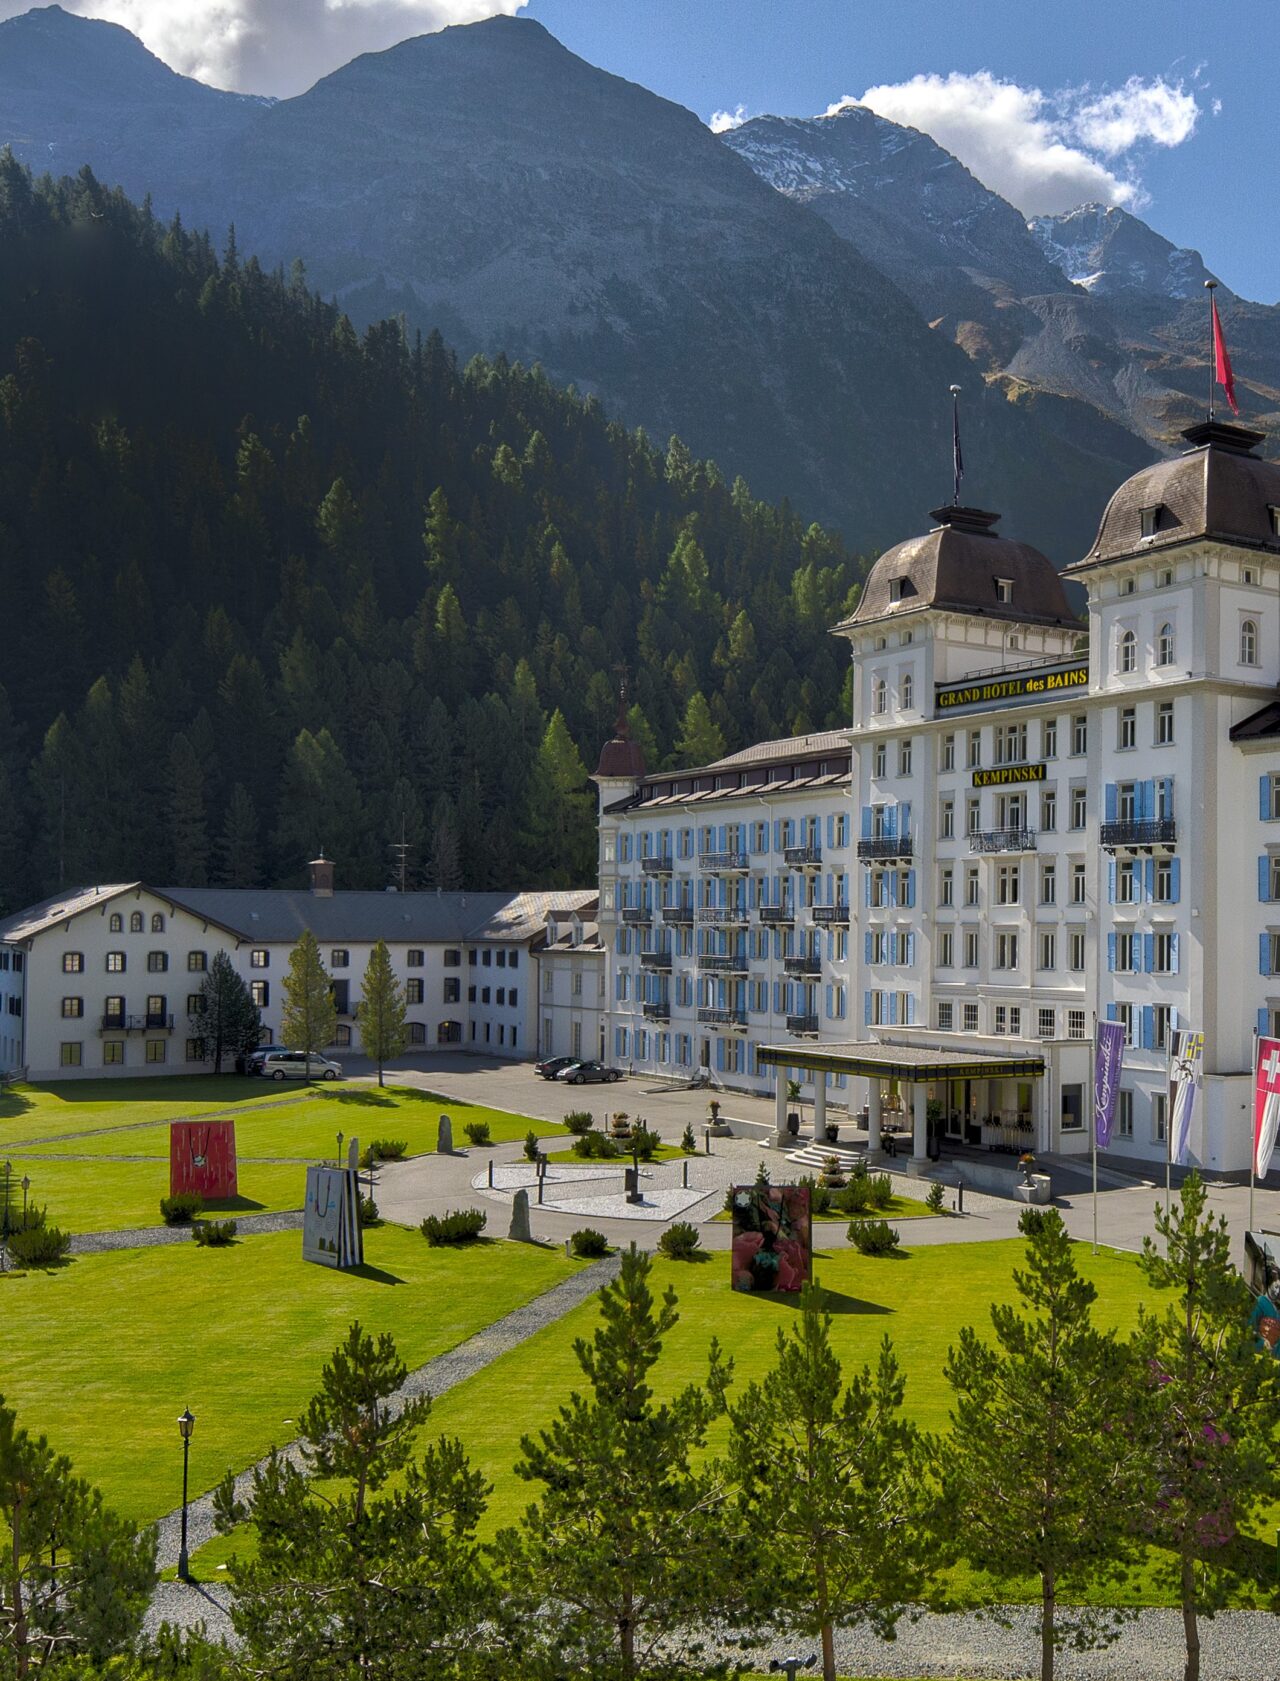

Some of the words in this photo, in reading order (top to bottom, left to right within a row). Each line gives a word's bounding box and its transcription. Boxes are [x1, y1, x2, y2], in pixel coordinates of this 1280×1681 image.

[939, 687, 980, 707] GRAND
[983, 680, 1024, 700] HOTEL
[1026, 678, 1044, 693] des
[1047, 669, 1088, 689] BAINS
[974, 765, 1043, 785] KEMPINSKI
[1095, 1036, 1112, 1134] Kempinski
